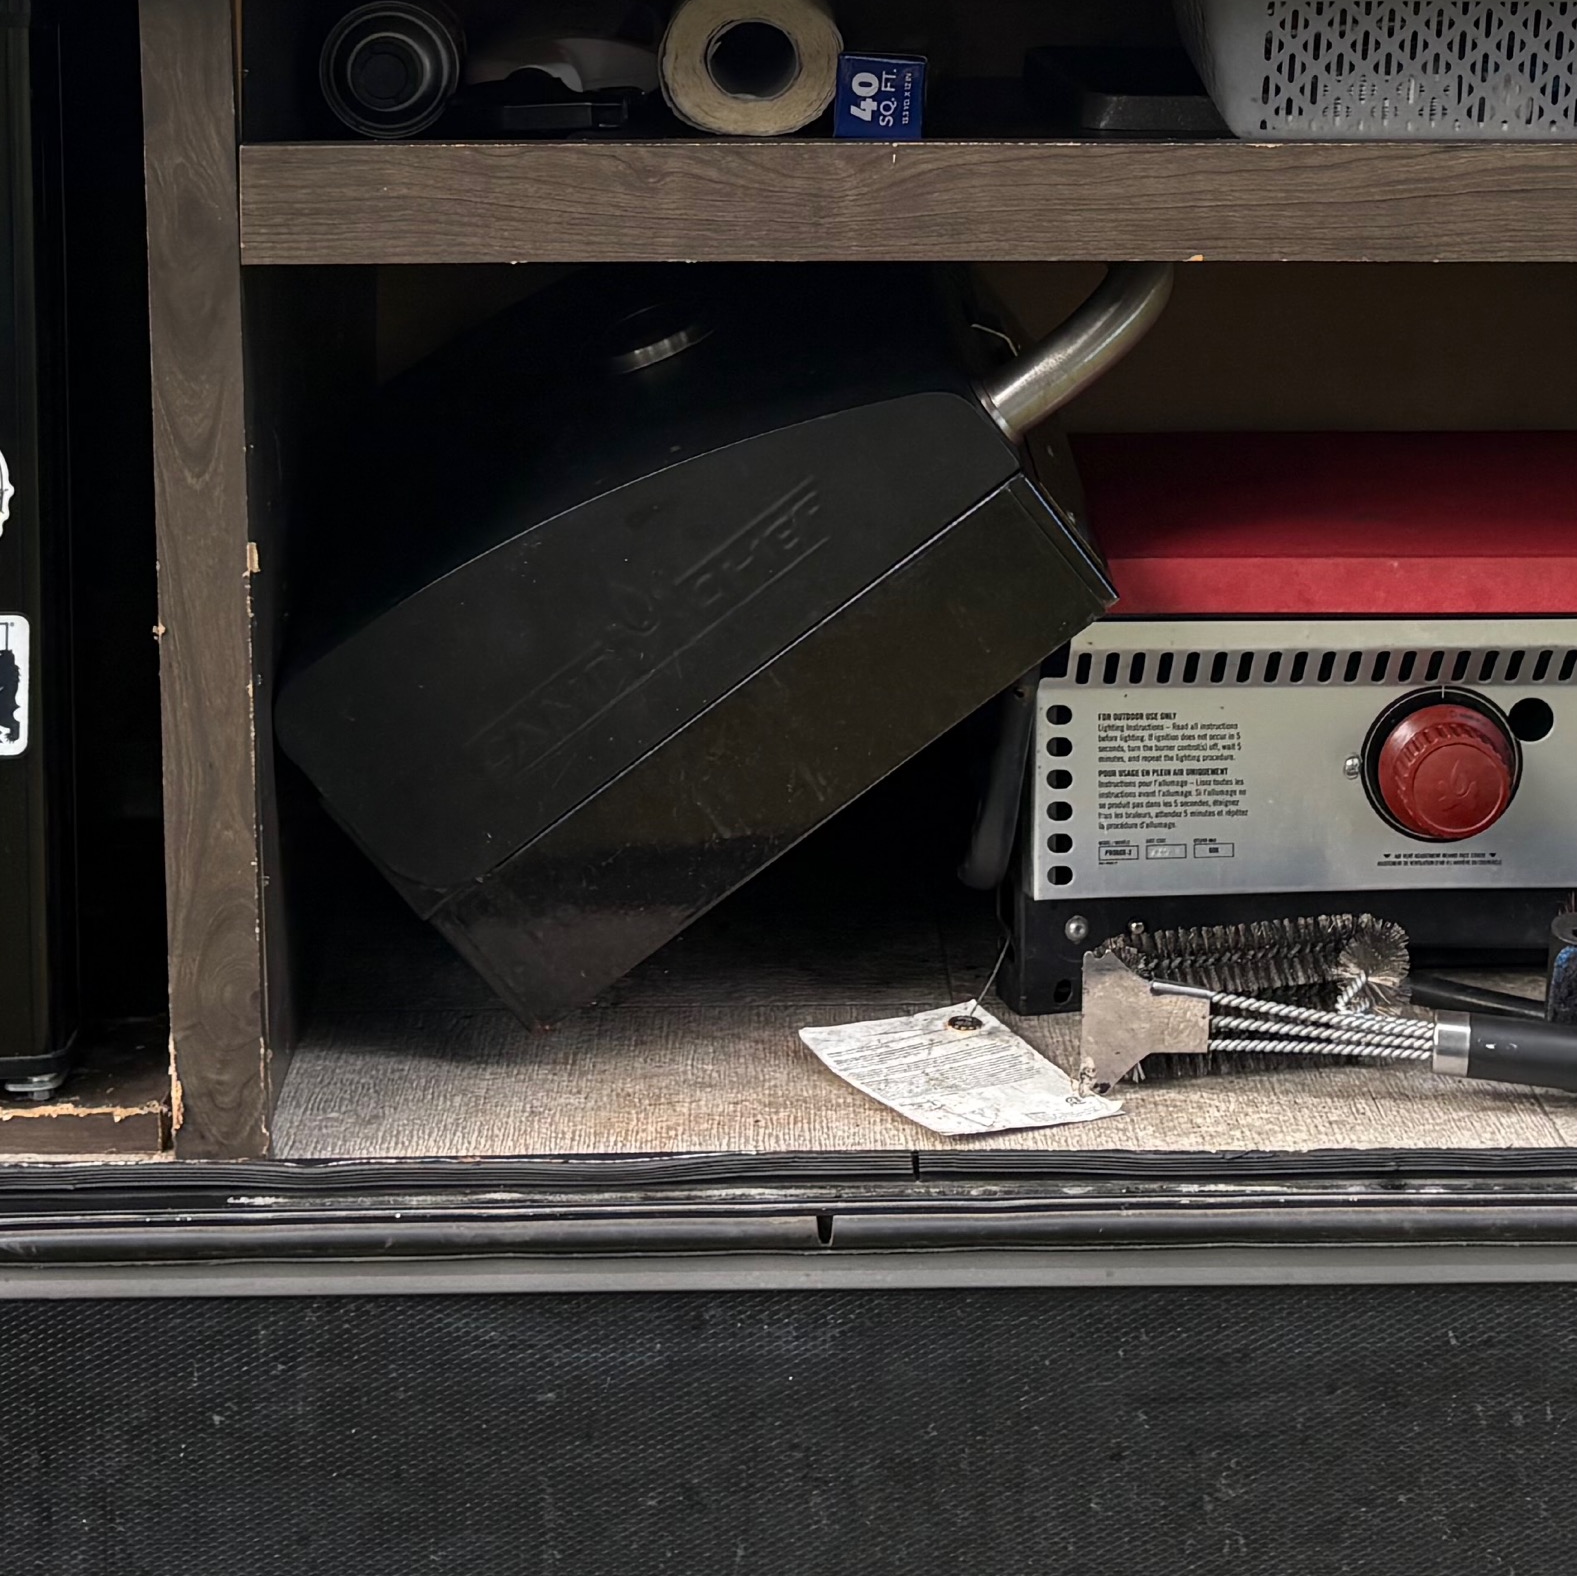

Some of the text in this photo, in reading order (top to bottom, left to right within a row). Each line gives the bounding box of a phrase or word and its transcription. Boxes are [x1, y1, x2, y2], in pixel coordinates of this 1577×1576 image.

[850, 72, 879, 121] 40
[879, 69, 897, 127] SQ. FT.
